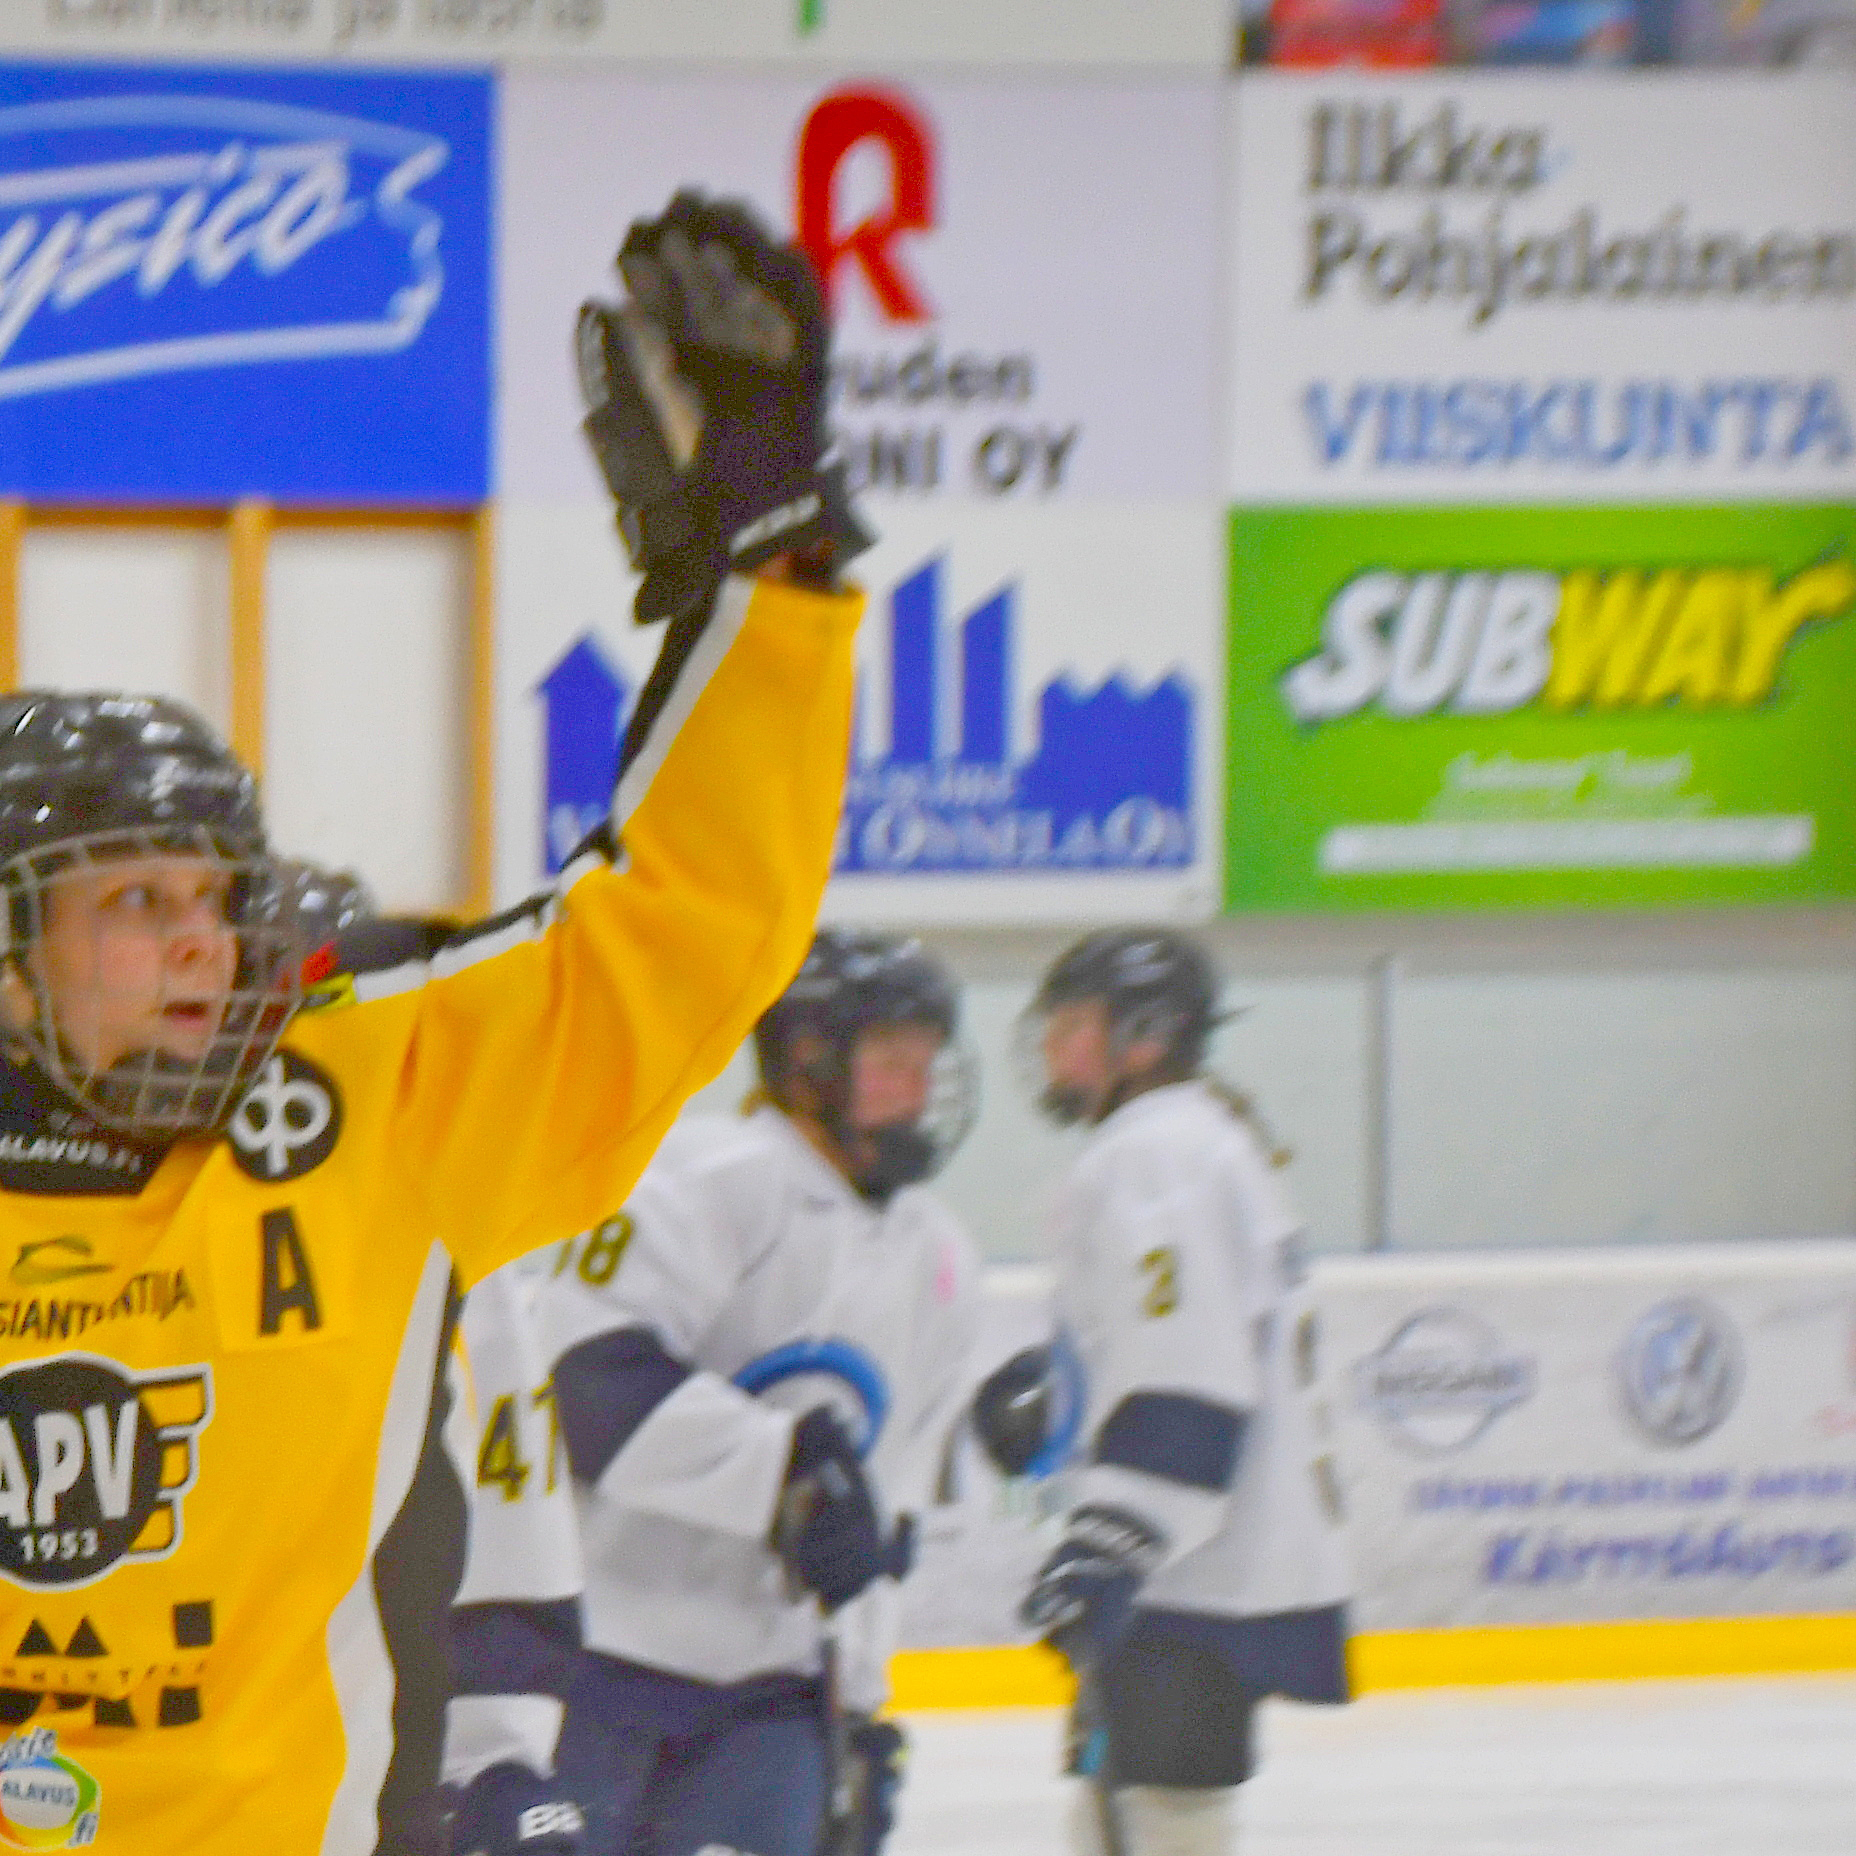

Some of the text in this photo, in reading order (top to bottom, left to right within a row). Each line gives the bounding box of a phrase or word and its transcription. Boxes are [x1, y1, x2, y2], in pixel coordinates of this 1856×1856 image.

[1308, 100, 1547, 192] Ilkka
[1306, 208, 1856, 330] Pohjalainen
[976, 425, 1081, 495] OY
[1304, 378, 1852, 466] VIISKUNTA
[1283, 558, 1852, 722] SUBWAY
[258, 1205, 324, 1338] A
[18, 1529, 101, 1564] 1953
